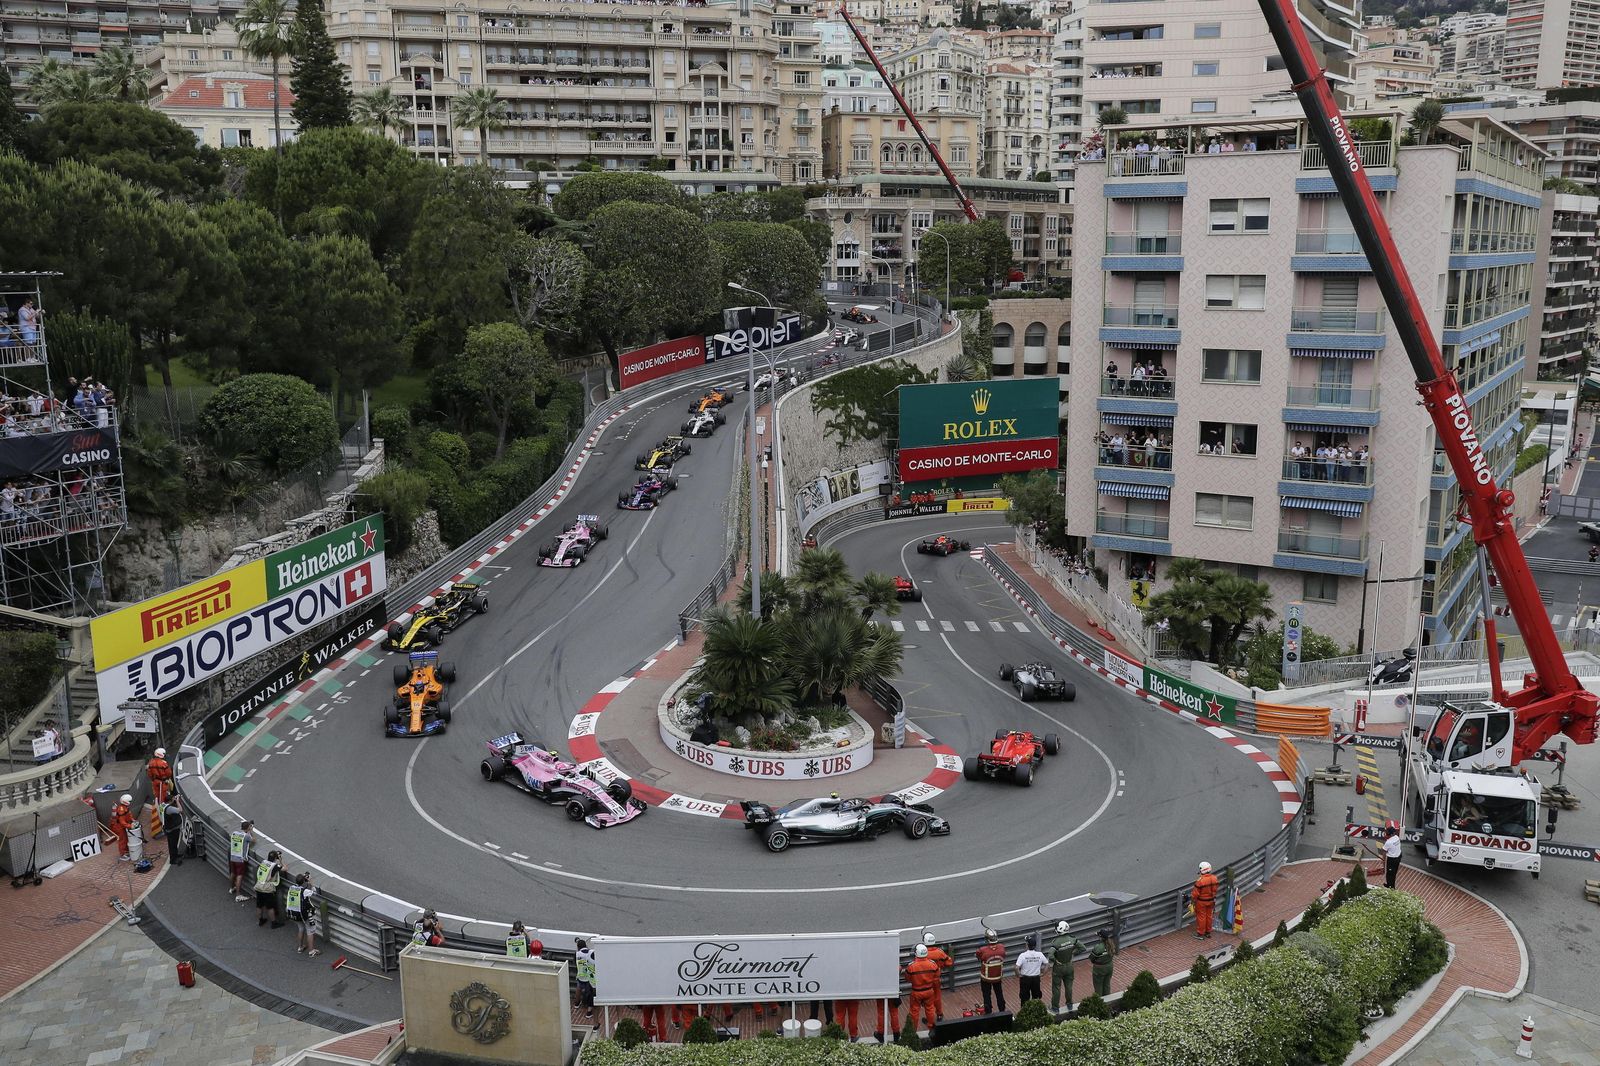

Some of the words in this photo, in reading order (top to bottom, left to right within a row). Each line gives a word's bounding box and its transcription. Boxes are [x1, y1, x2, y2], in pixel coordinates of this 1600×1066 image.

[1330, 116, 1359, 172] PIOVANO
[623, 361, 645, 376] CASINO
[645, 358, 654, 368] DE
[654, 347, 700, 367] MONTE-CARLO
[943, 418, 1018, 440] ROLEX
[1445, 393, 1492, 485] PIOVANO
[62, 448, 110, 465] CASINO
[908, 457, 952, 470] CASINO
[954, 455, 970, 466] DE
[972, 449, 1052, 465] MONTE-CARLO
[933, 487, 955, 495] ROLEX
[889, 507, 913, 519] JOHNNIE
[919, 505, 943, 514] WALKER
[963, 500, 994, 510] PIRELLI
[277, 538, 358, 592] Heineken
[140, 579, 232, 643] PIRELLI
[150, 576, 340, 696] BIOPTRON
[218, 670, 296, 736] JOHNNIE
[313, 618, 375, 665] WALKER
[1149, 673, 1203, 713] Heineken
[1356, 737, 1398, 747] PIOVANO
[687, 745, 714, 766] UBS
[822, 755, 852, 774] UBS
[747, 759, 785, 776] UBS
[909, 784, 936, 797] UBS
[685, 801, 722, 814] UBS
[1371, 830, 1420, 842] PIONO
[1451, 833, 1532, 851] PIOVANO
[72, 838, 97, 860] FCY
[1538, 845, 1591, 858] PIOVANO
[677, 942, 818, 982] Fairmont
[676, 982, 747, 997] MONTE
[754, 980, 820, 994] CARLO
